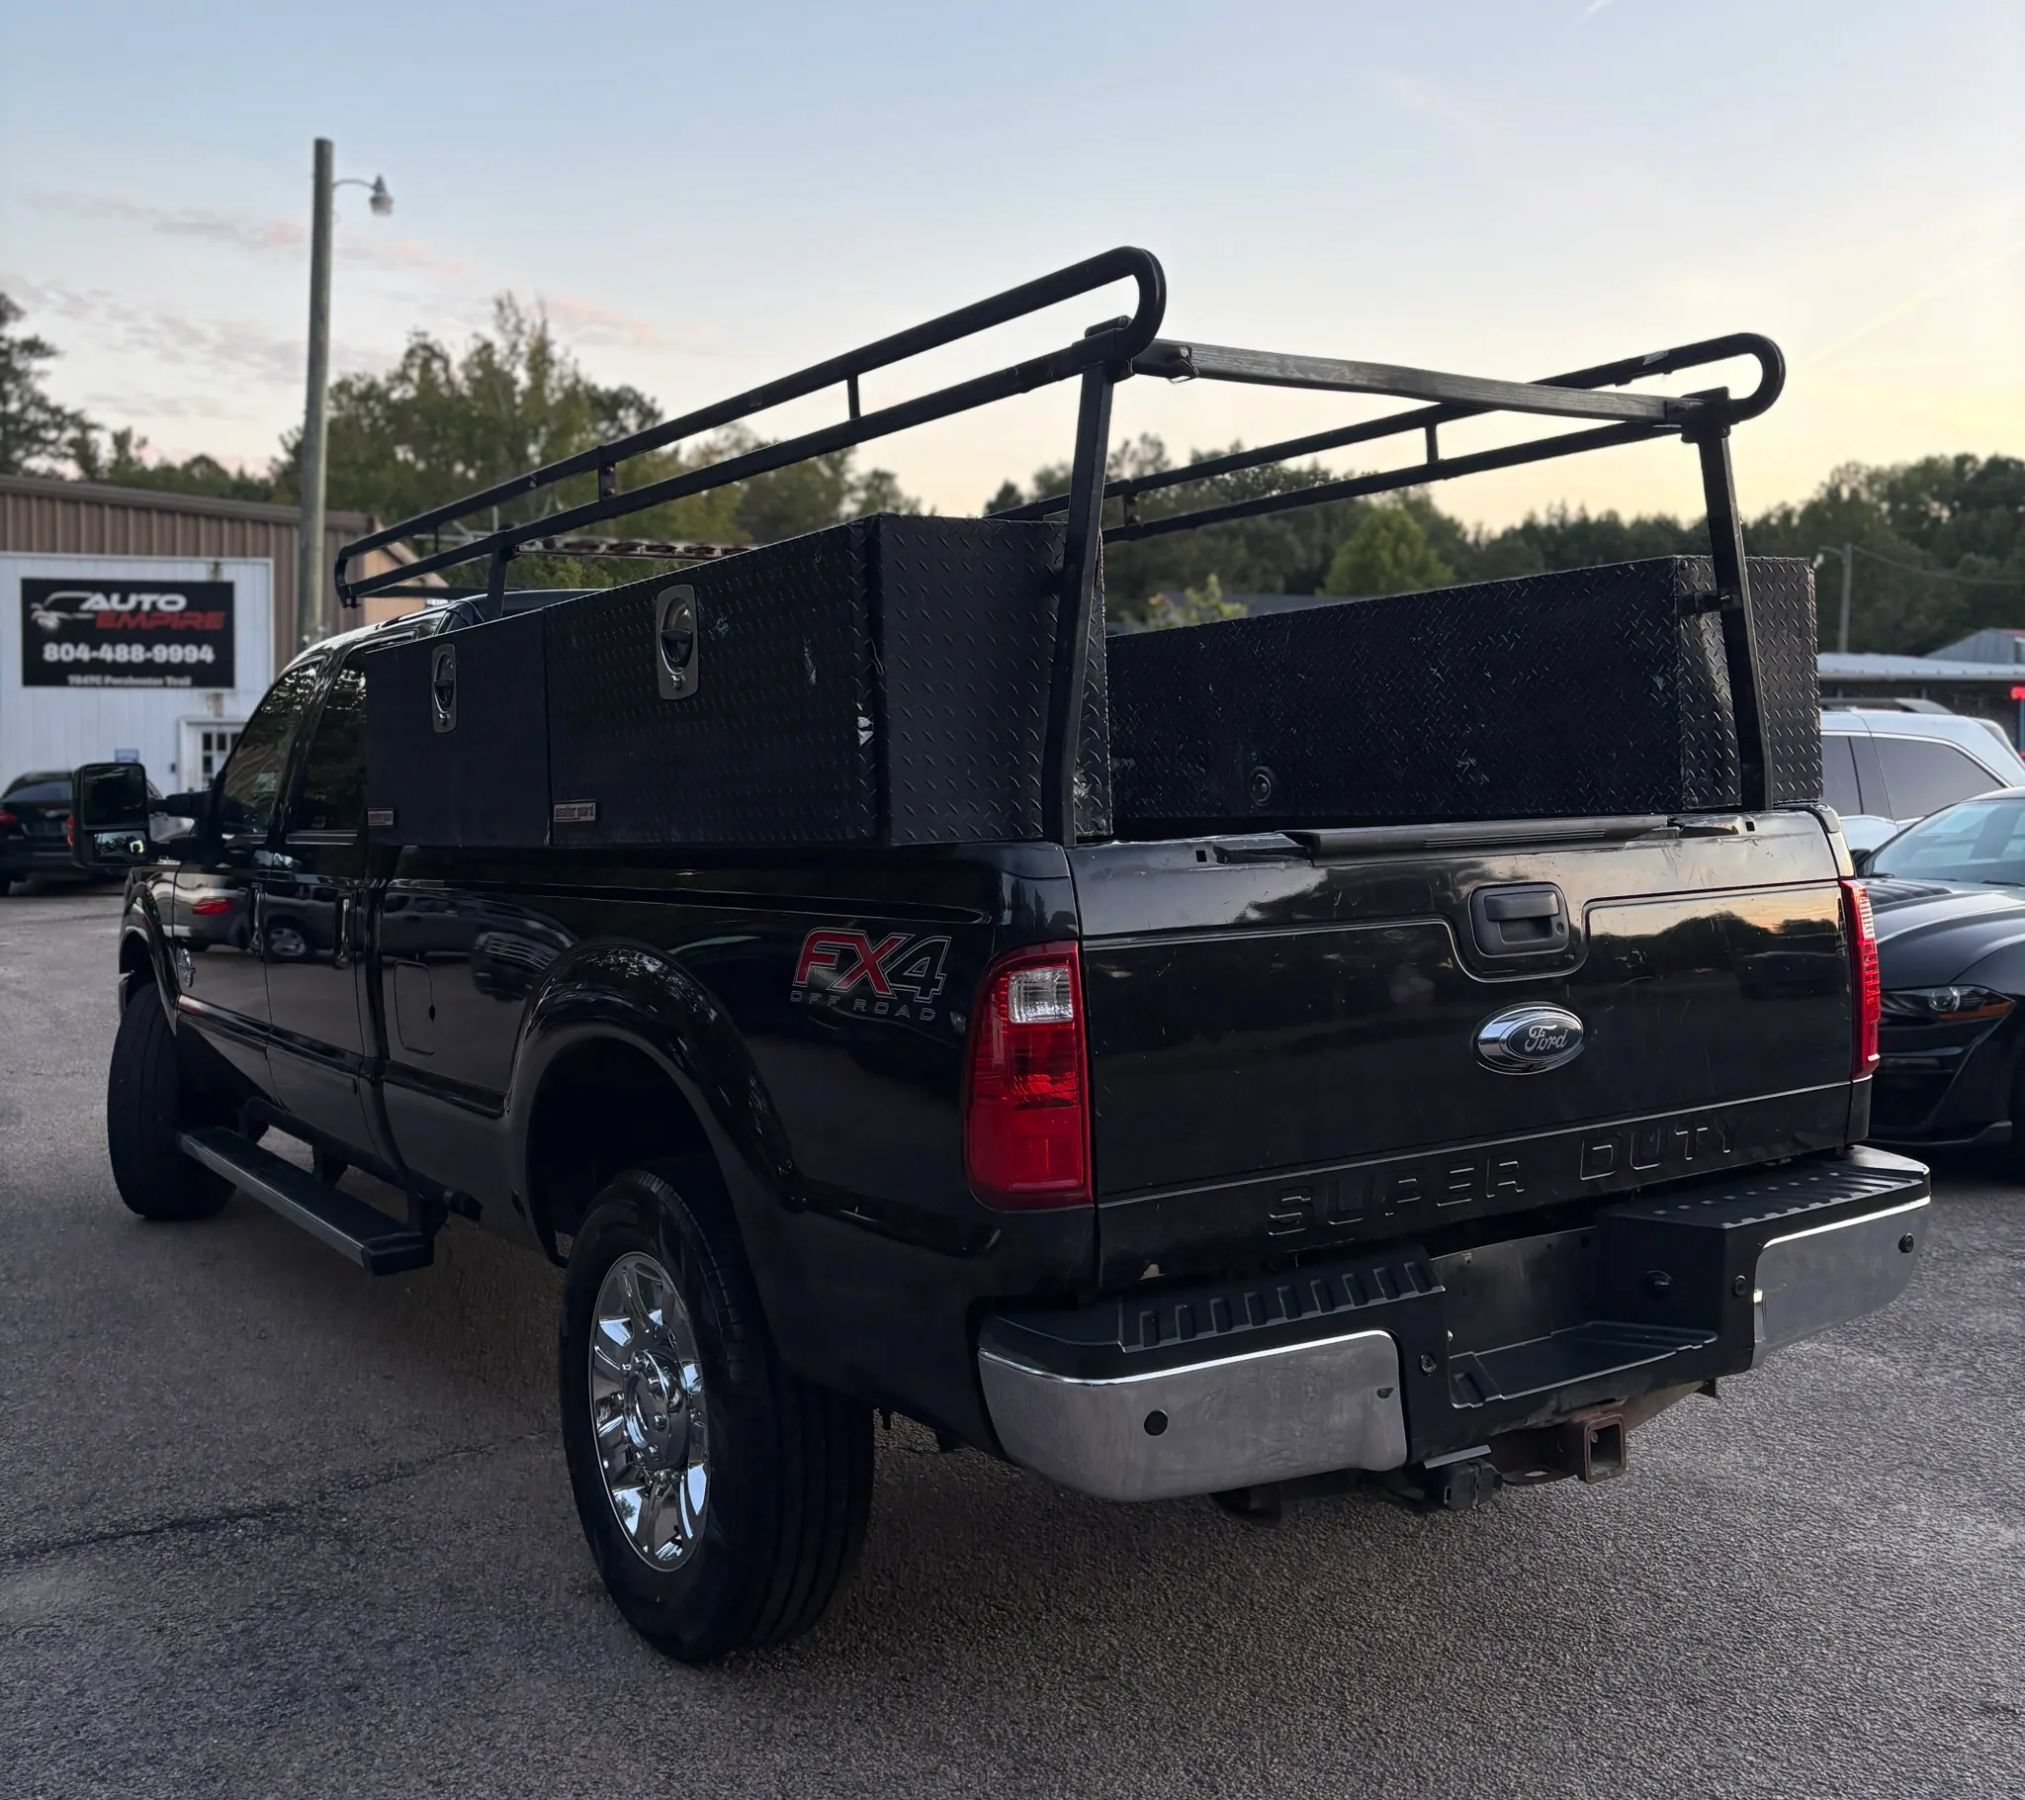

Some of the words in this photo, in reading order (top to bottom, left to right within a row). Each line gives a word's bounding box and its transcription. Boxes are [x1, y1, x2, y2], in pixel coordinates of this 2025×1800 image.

[79, 592, 188, 612] AUTO
[95, 610, 226, 631] EMPIRE
[42, 642, 215, 664] 804-488-9994
[791, 926, 952, 1004] FX4
[789, 990, 841, 1007] OFF
[852, 998, 937, 1022] ROAD
[1523, 1023, 1569, 1053] Ford
[1266, 1152, 1526, 1237] SUPER
[1579, 1114, 1745, 1182] DUTY
